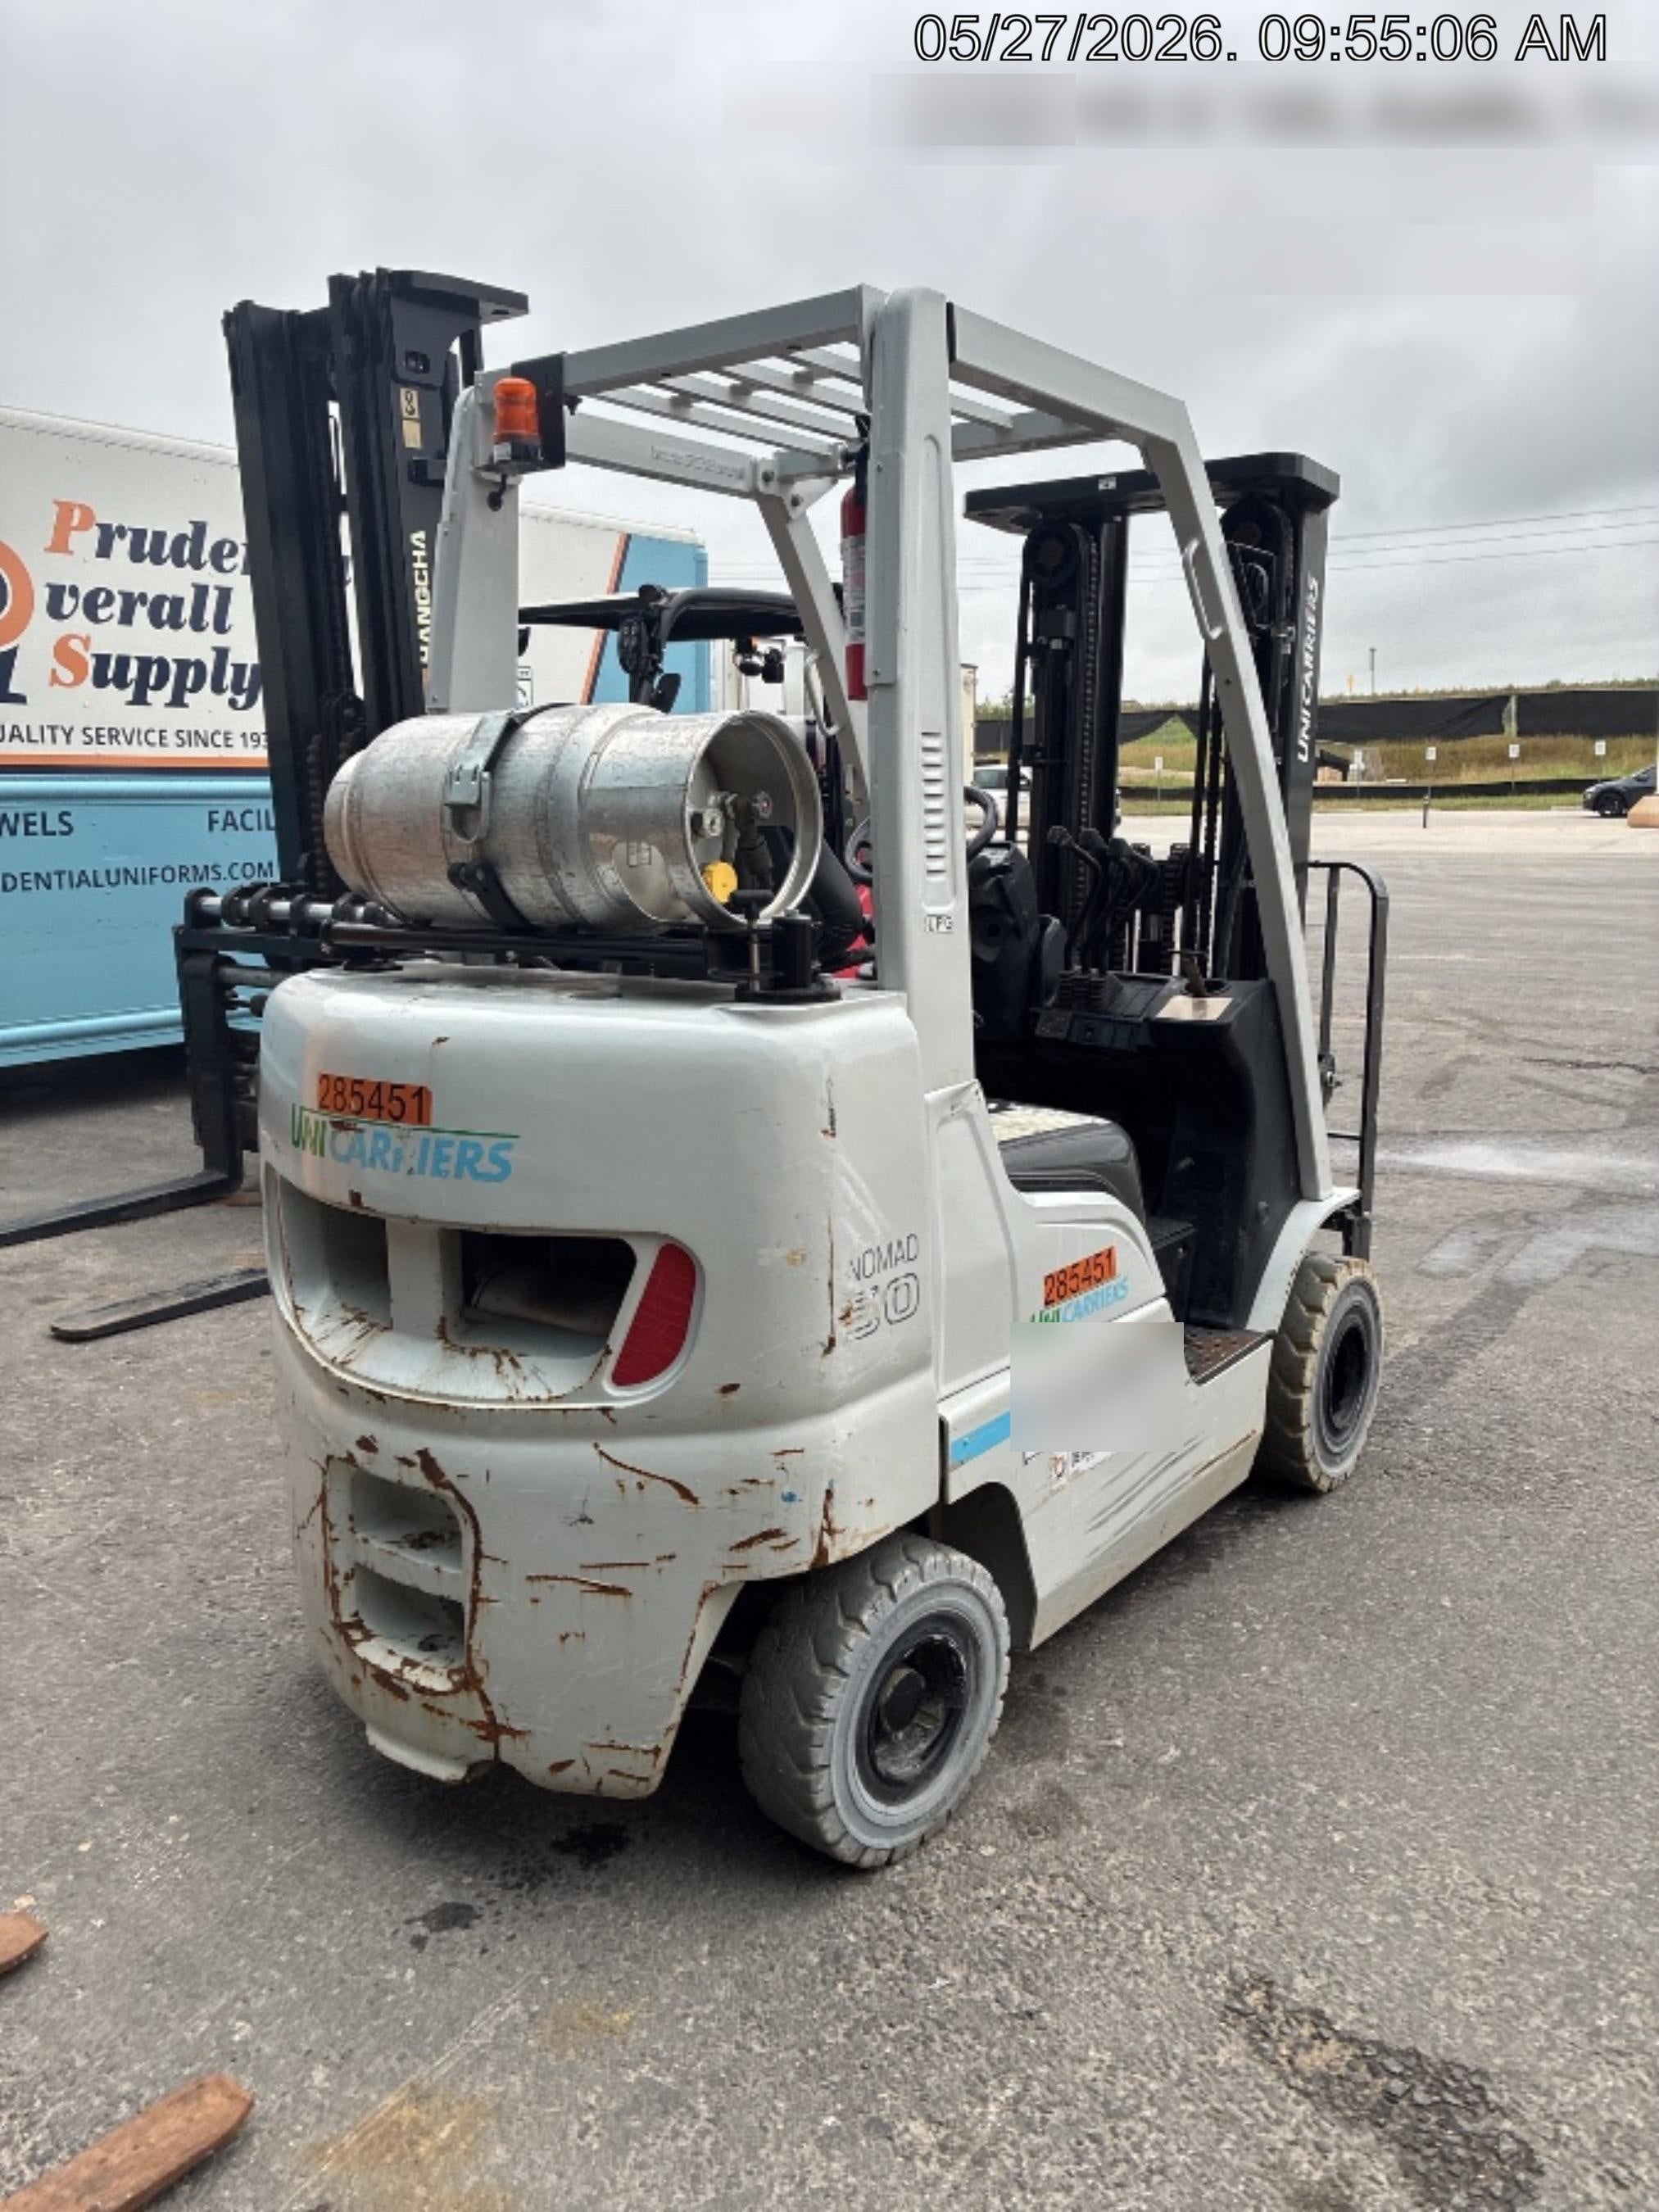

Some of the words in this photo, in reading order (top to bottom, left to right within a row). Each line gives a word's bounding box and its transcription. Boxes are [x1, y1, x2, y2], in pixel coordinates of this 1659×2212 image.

[48, 633, 263, 711] Supply
[82, 726, 169, 748] SERVICE
[175, 729, 234, 749] SINCE
[319, 1074, 425, 1125] 285451
[849, 1233, 920, 1282] NOMAD
[1044, 1246, 1116, 1308] 285451
